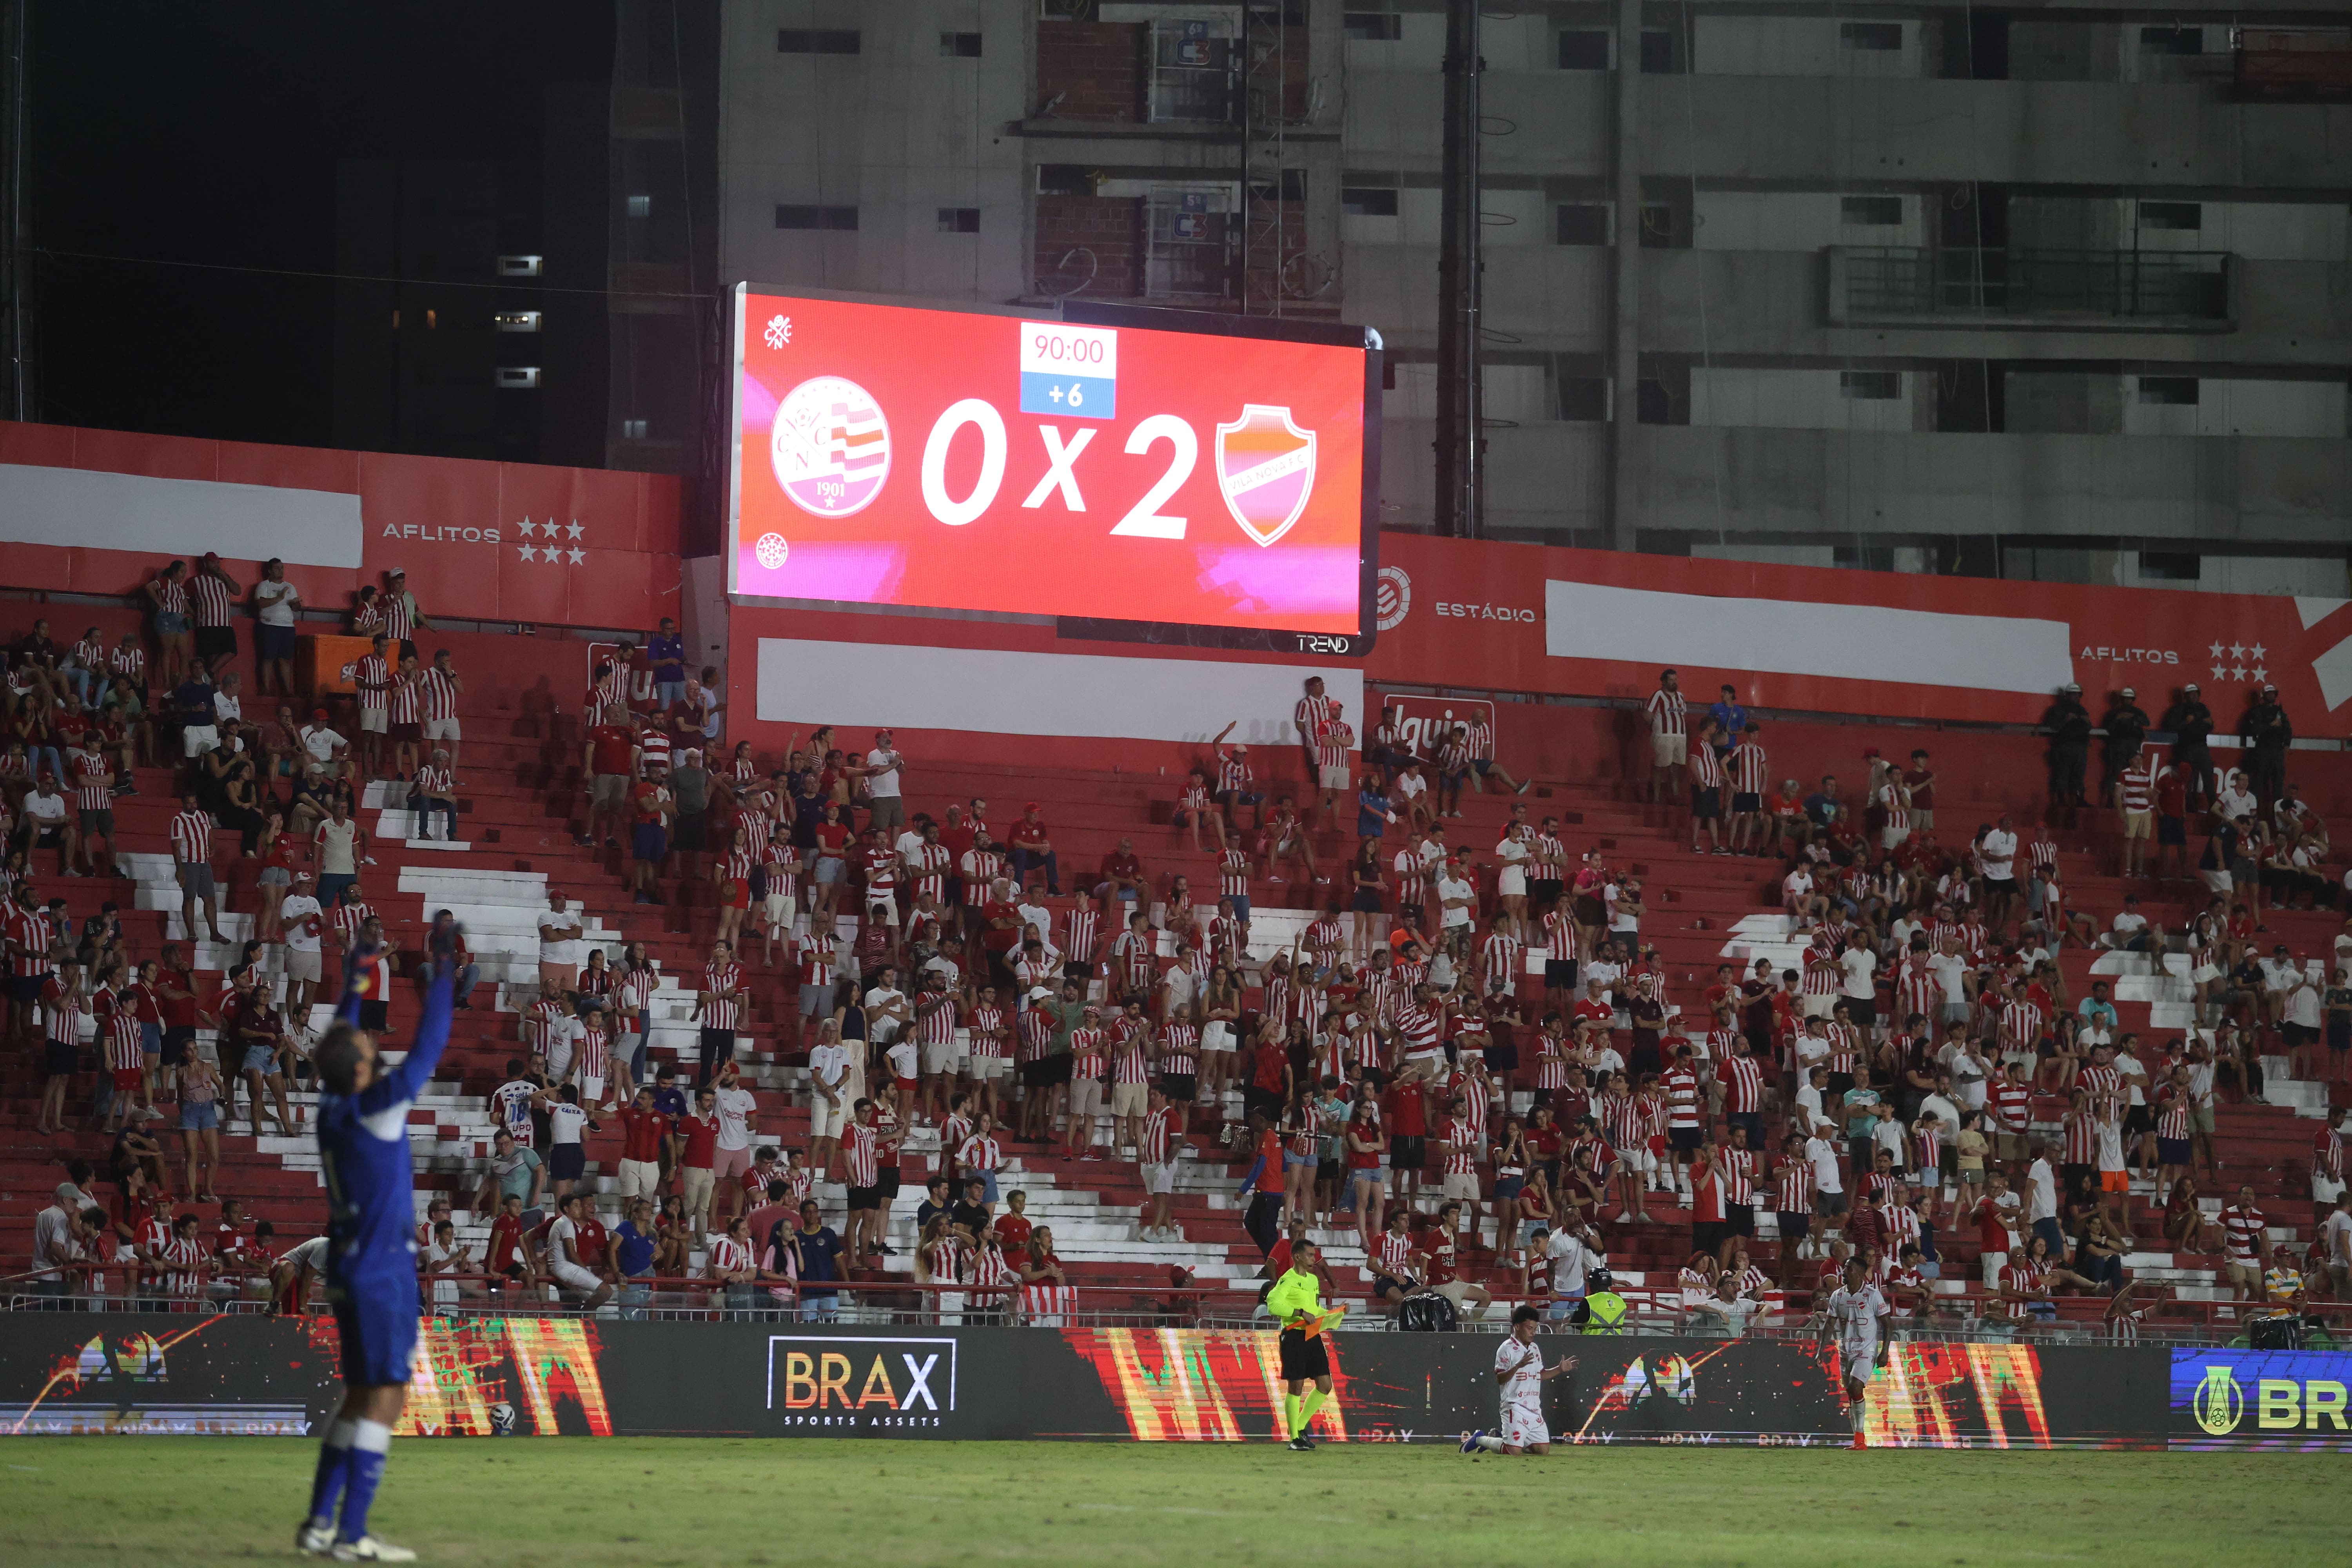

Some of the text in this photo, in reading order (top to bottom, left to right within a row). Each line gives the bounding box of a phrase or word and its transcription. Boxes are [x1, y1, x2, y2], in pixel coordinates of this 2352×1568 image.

[1035, 335, 1103, 363] 90:00
[921, 398, 1007, 526] 0
[1109, 414, 1198, 540] 2
[816, 481, 844, 497] 1901
[382, 523, 501, 543] AFLITOS
[1436, 602, 1536, 623] ESTÁDIO
[1296, 635, 1349, 653] TREND
[2081, 646, 2180, 664] AFLITOS
[511, 1102, 526, 1123] 18
[875, 1149, 884, 1158] 10
[785, 1352, 939, 1410] BRAX
[2258, 1379, 2352, 1430] BR
[784, 1416, 940, 1426] SPORTS ASSETS
